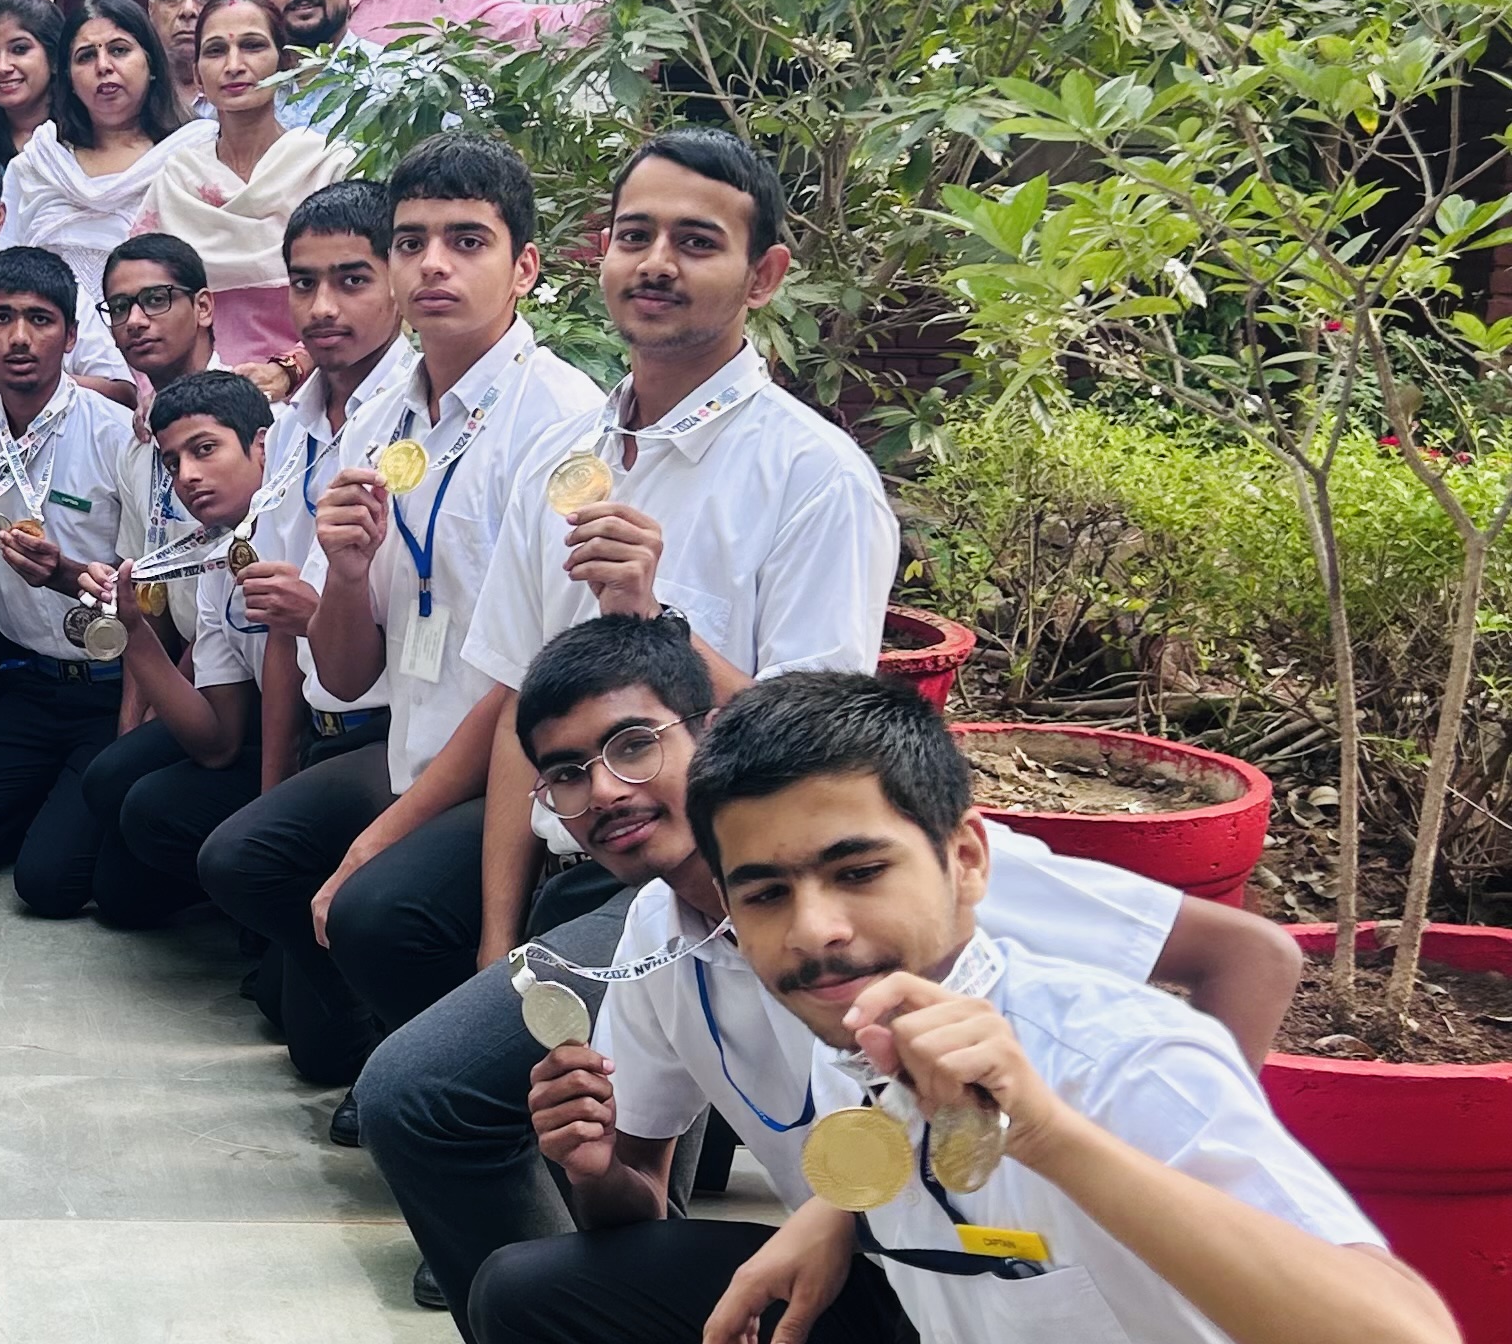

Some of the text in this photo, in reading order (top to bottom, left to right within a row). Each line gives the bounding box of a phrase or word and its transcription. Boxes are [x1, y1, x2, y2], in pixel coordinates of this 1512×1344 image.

[671, 415, 702, 433] 2024
[183, 564, 206, 577] 2024
[591, 969, 632, 980] 2024
